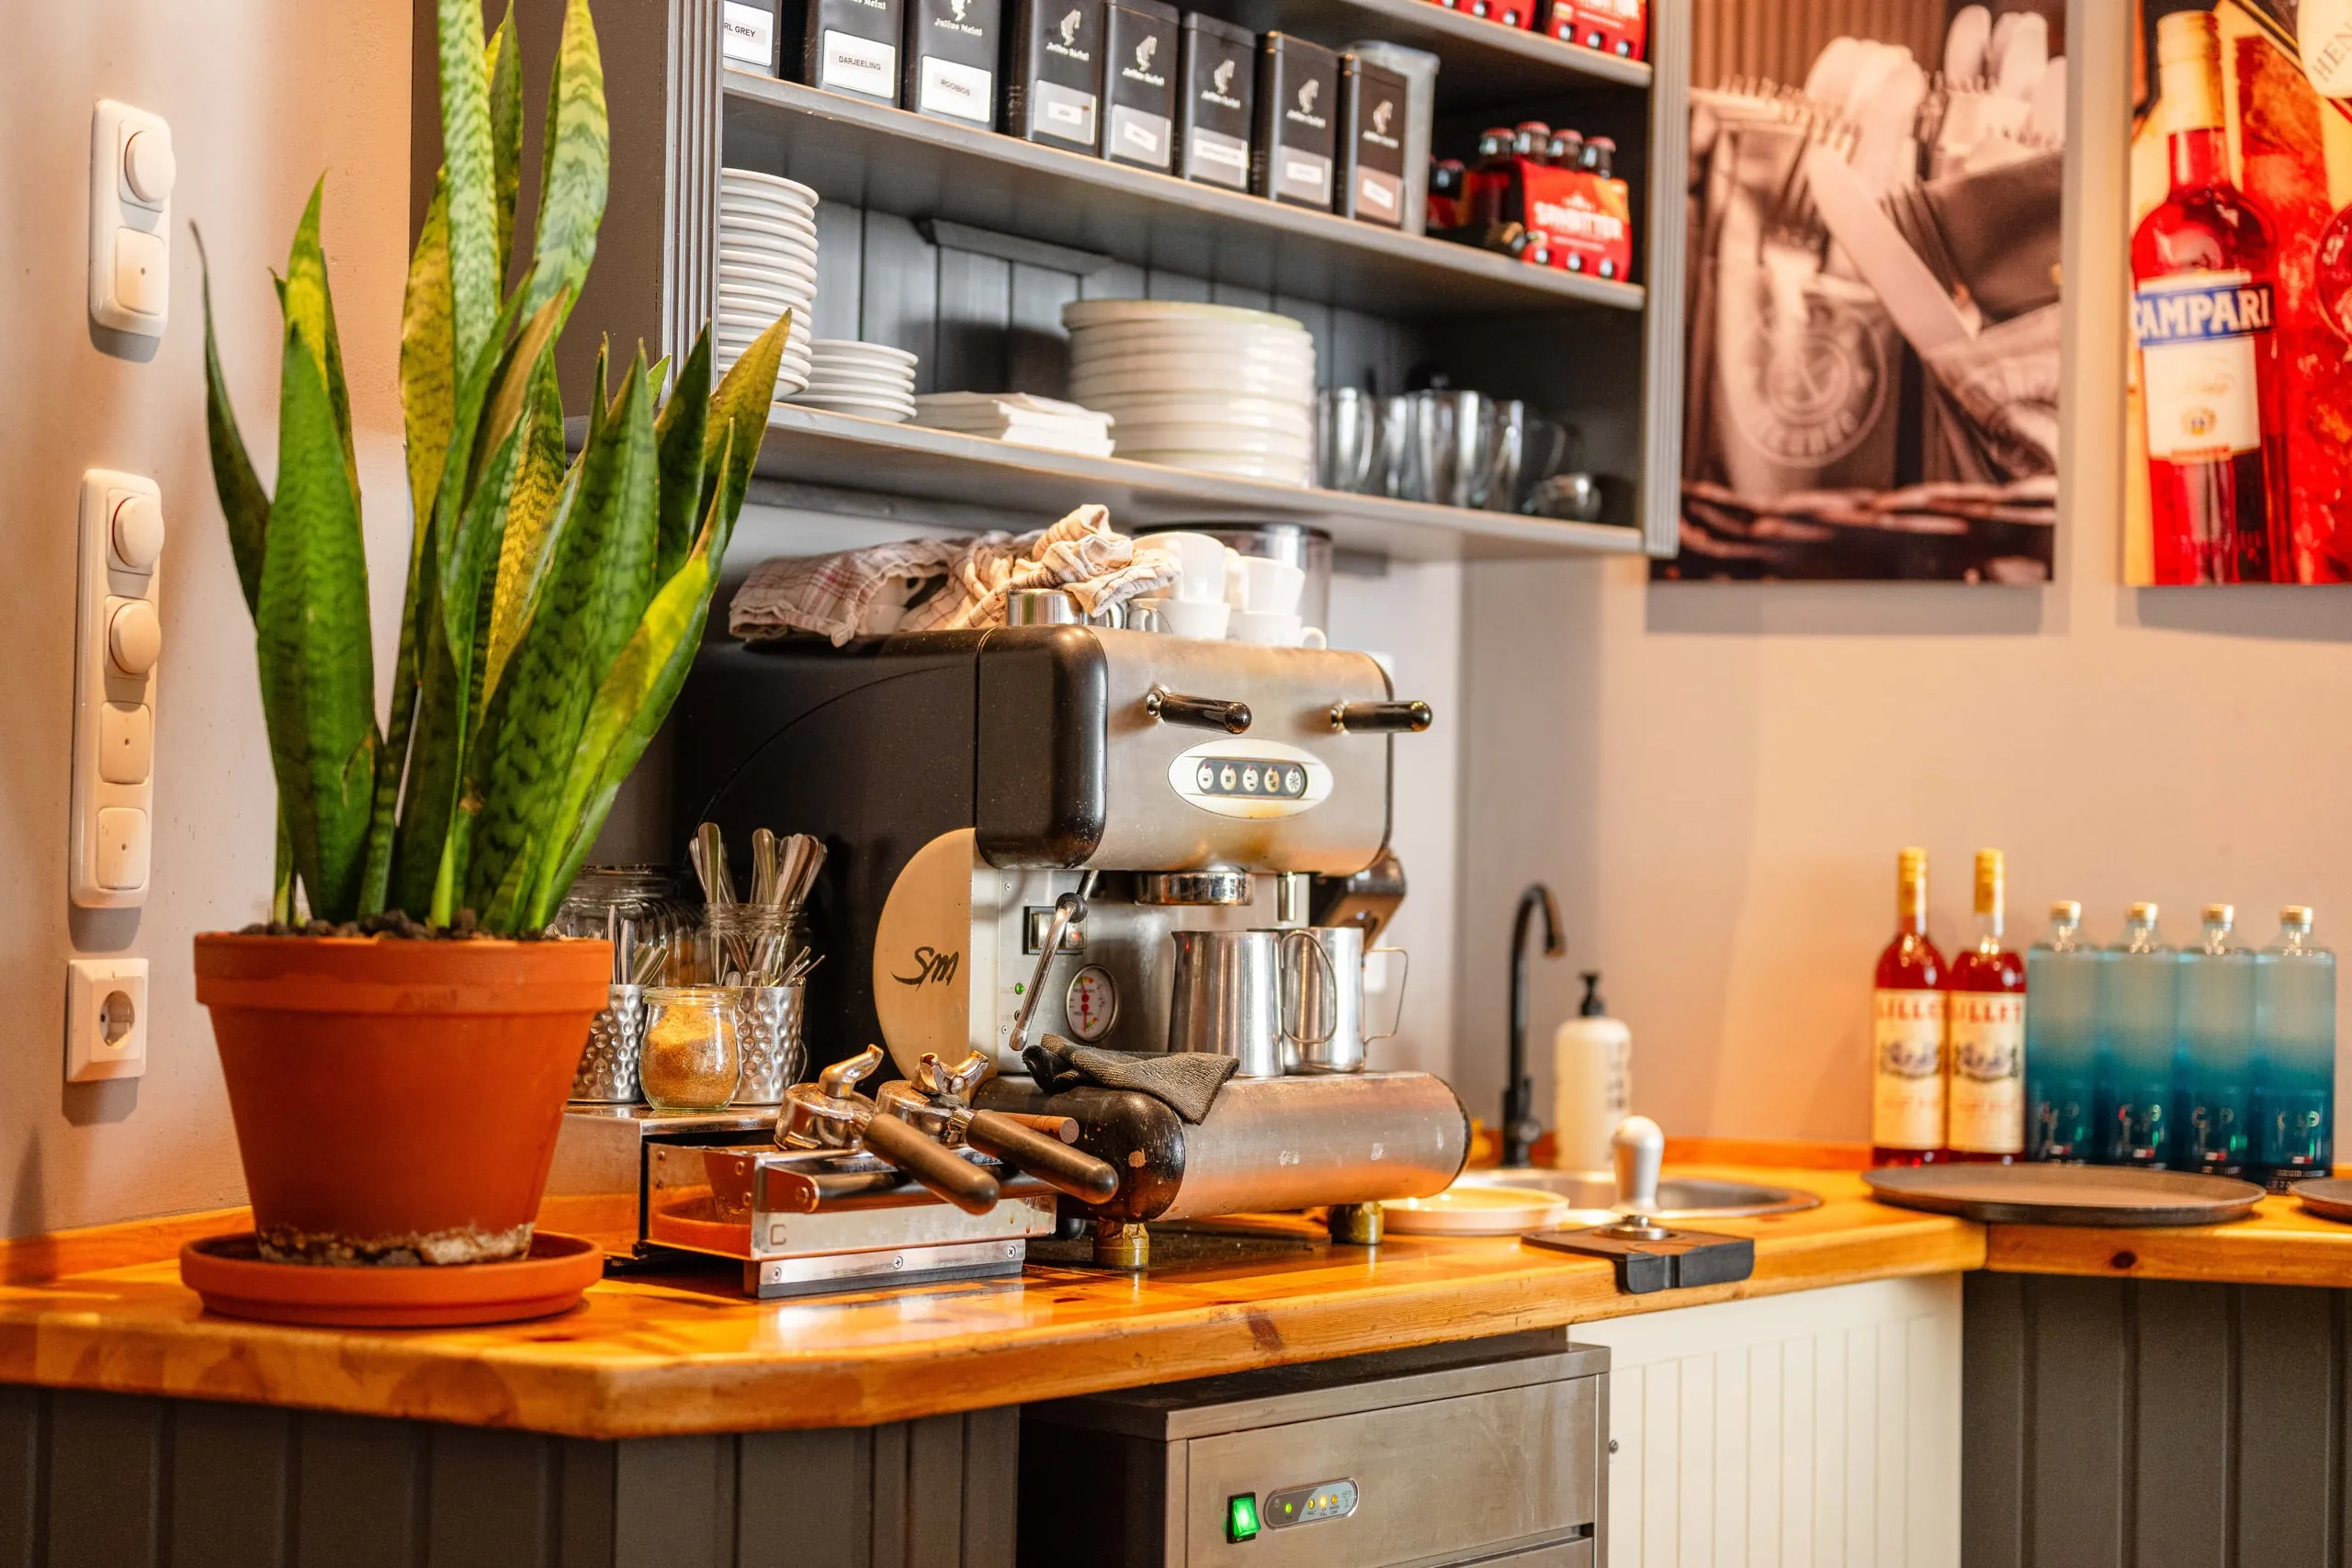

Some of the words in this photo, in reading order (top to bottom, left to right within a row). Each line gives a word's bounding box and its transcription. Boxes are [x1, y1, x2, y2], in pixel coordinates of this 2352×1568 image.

[735, 26, 756, 38] GREY
[839, 55, 881, 71] DARJEELING
[941, 78, 971, 96] ROOIBOS
